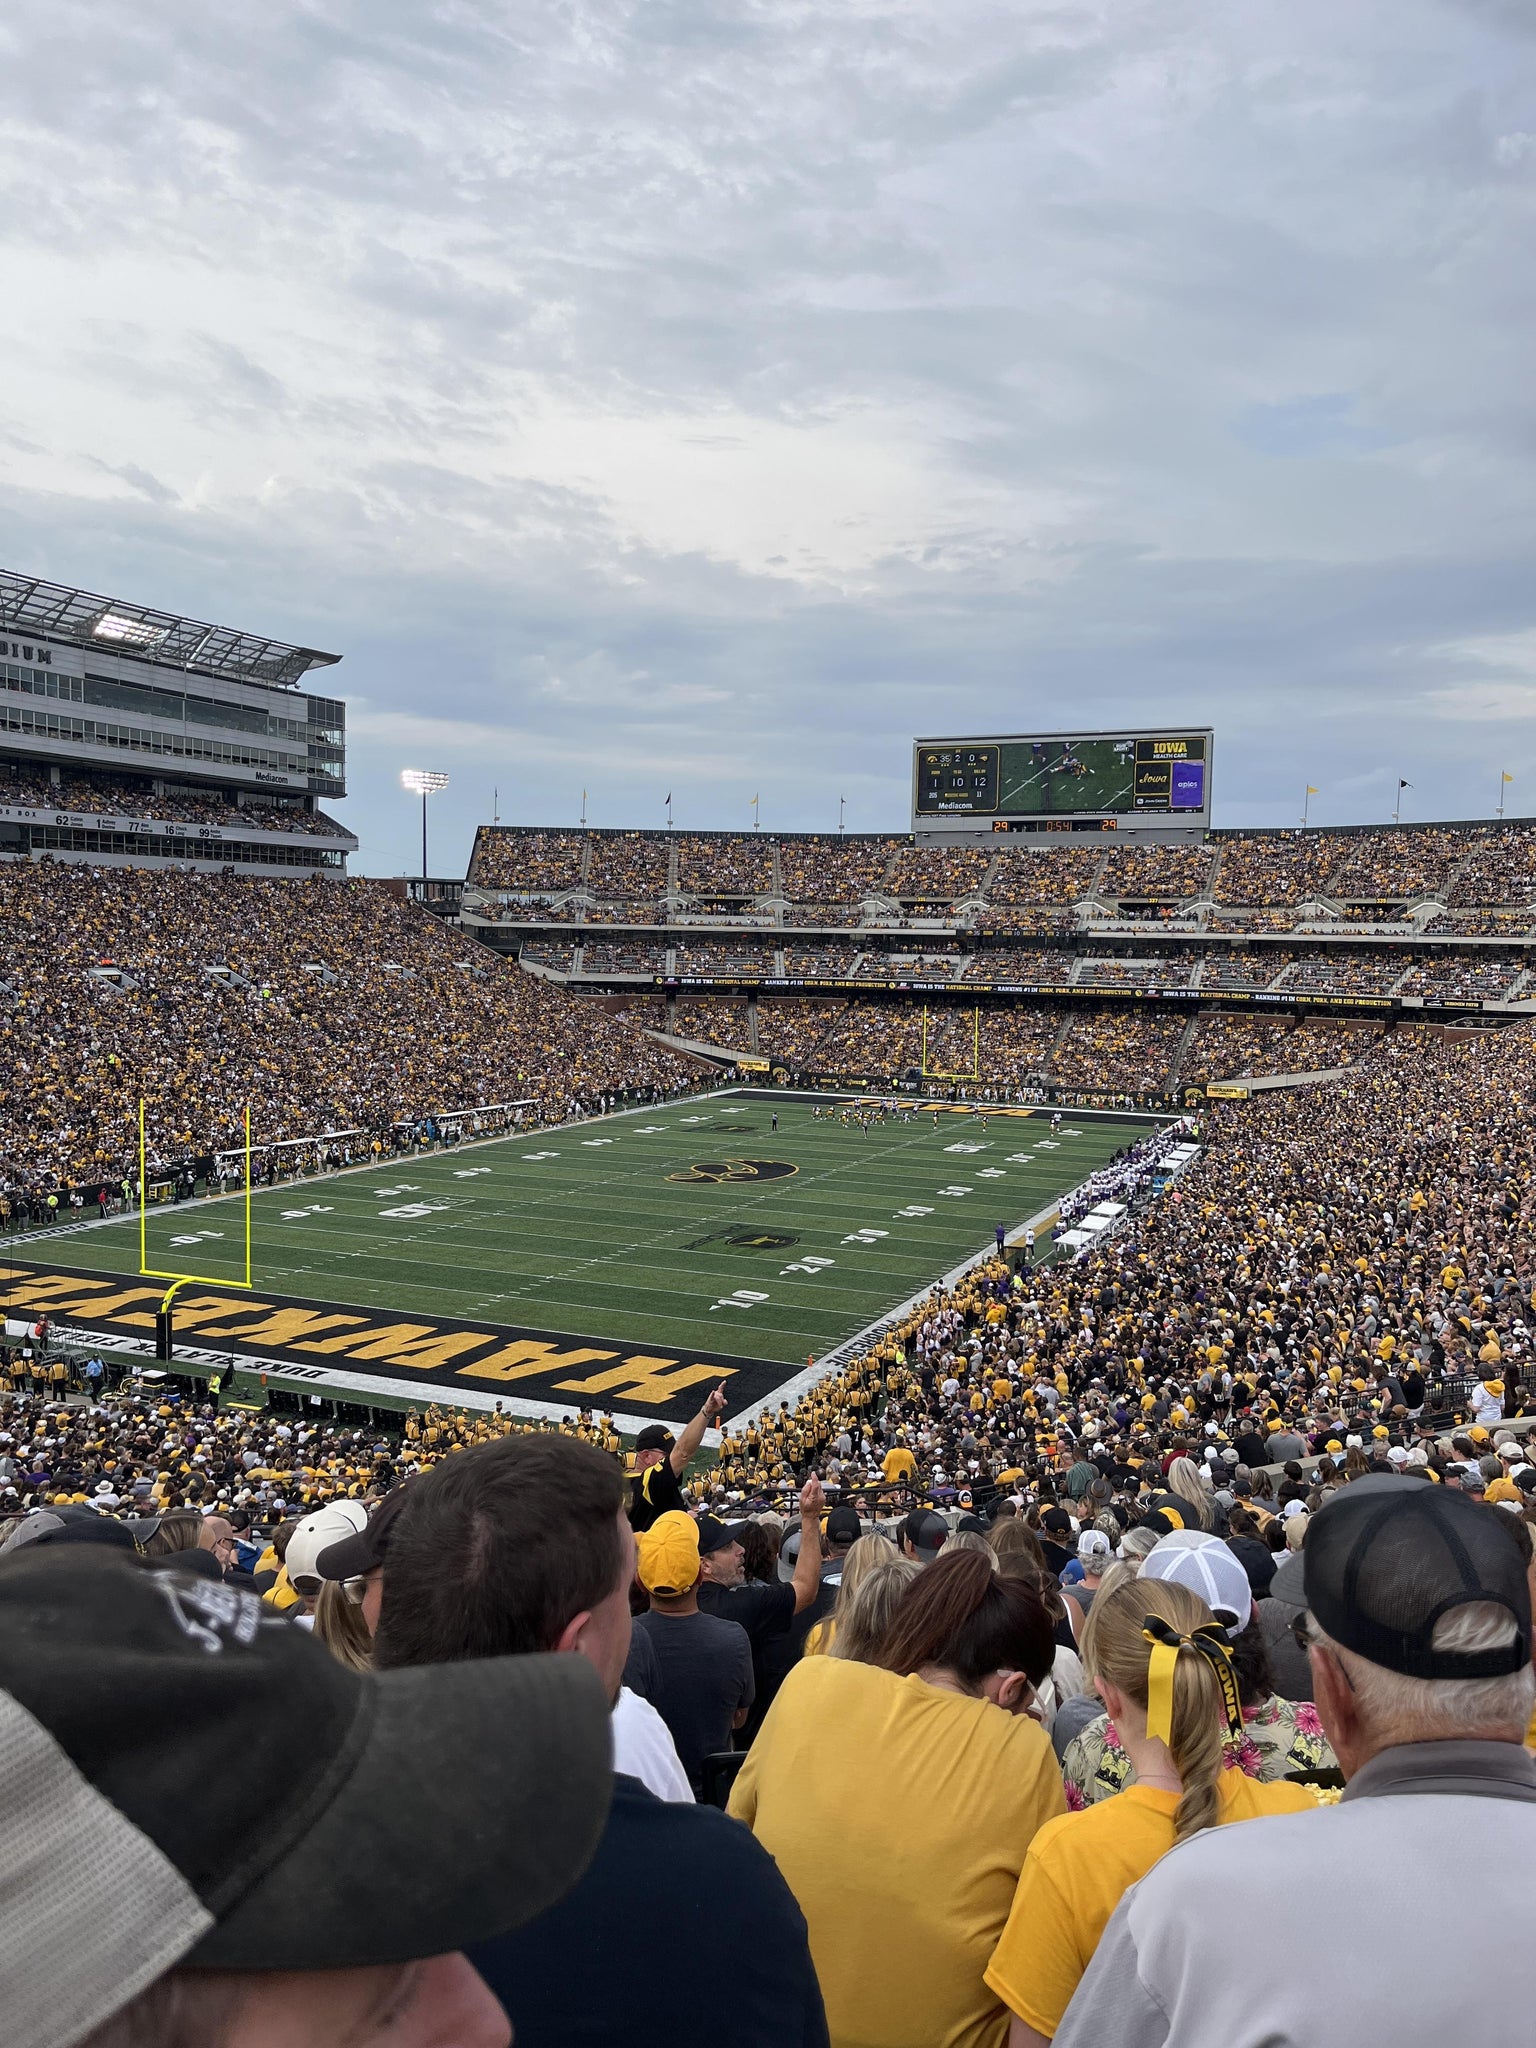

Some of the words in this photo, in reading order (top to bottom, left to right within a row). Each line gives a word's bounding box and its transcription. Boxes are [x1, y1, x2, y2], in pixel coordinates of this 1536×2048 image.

[1153, 742, 1187, 754] IOWA
[255, 771, 288, 784] Mediacom
[952, 778, 964, 786] 10
[975, 777, 986, 786] 12
[1139, 772, 1167, 784] Iowa
[56, 815, 69, 825] 62
[97, 819, 101, 828] 1
[128, 821, 140, 831] 77
[1102, 820, 1117, 831] 29
[165, 825, 174, 835] 16
[994, 821, 1008, 832] 29
[1046, 821, 1070, 832] 0:54
[199, 828, 210, 838] 99
[937, 1185, 974, 1197] 50
[280, 1204, 335, 1218] 20
[898, 1205, 936, 1217] 40
[169, 1230, 224, 1244] 10
[847, 1228, 890, 1244] 30
[785, 1256, 836, 1274] 20
[717, 1290, 770, 1309] 10
[0, 1268, 740, 1403] HAWKEYE
[131, 1343, 242, 1364] SLATR
[244, 1361, 329, 1378] DUKE
[854, 1432, 859, 1442] 7
[1214, 1656, 1239, 1723] IOWA
